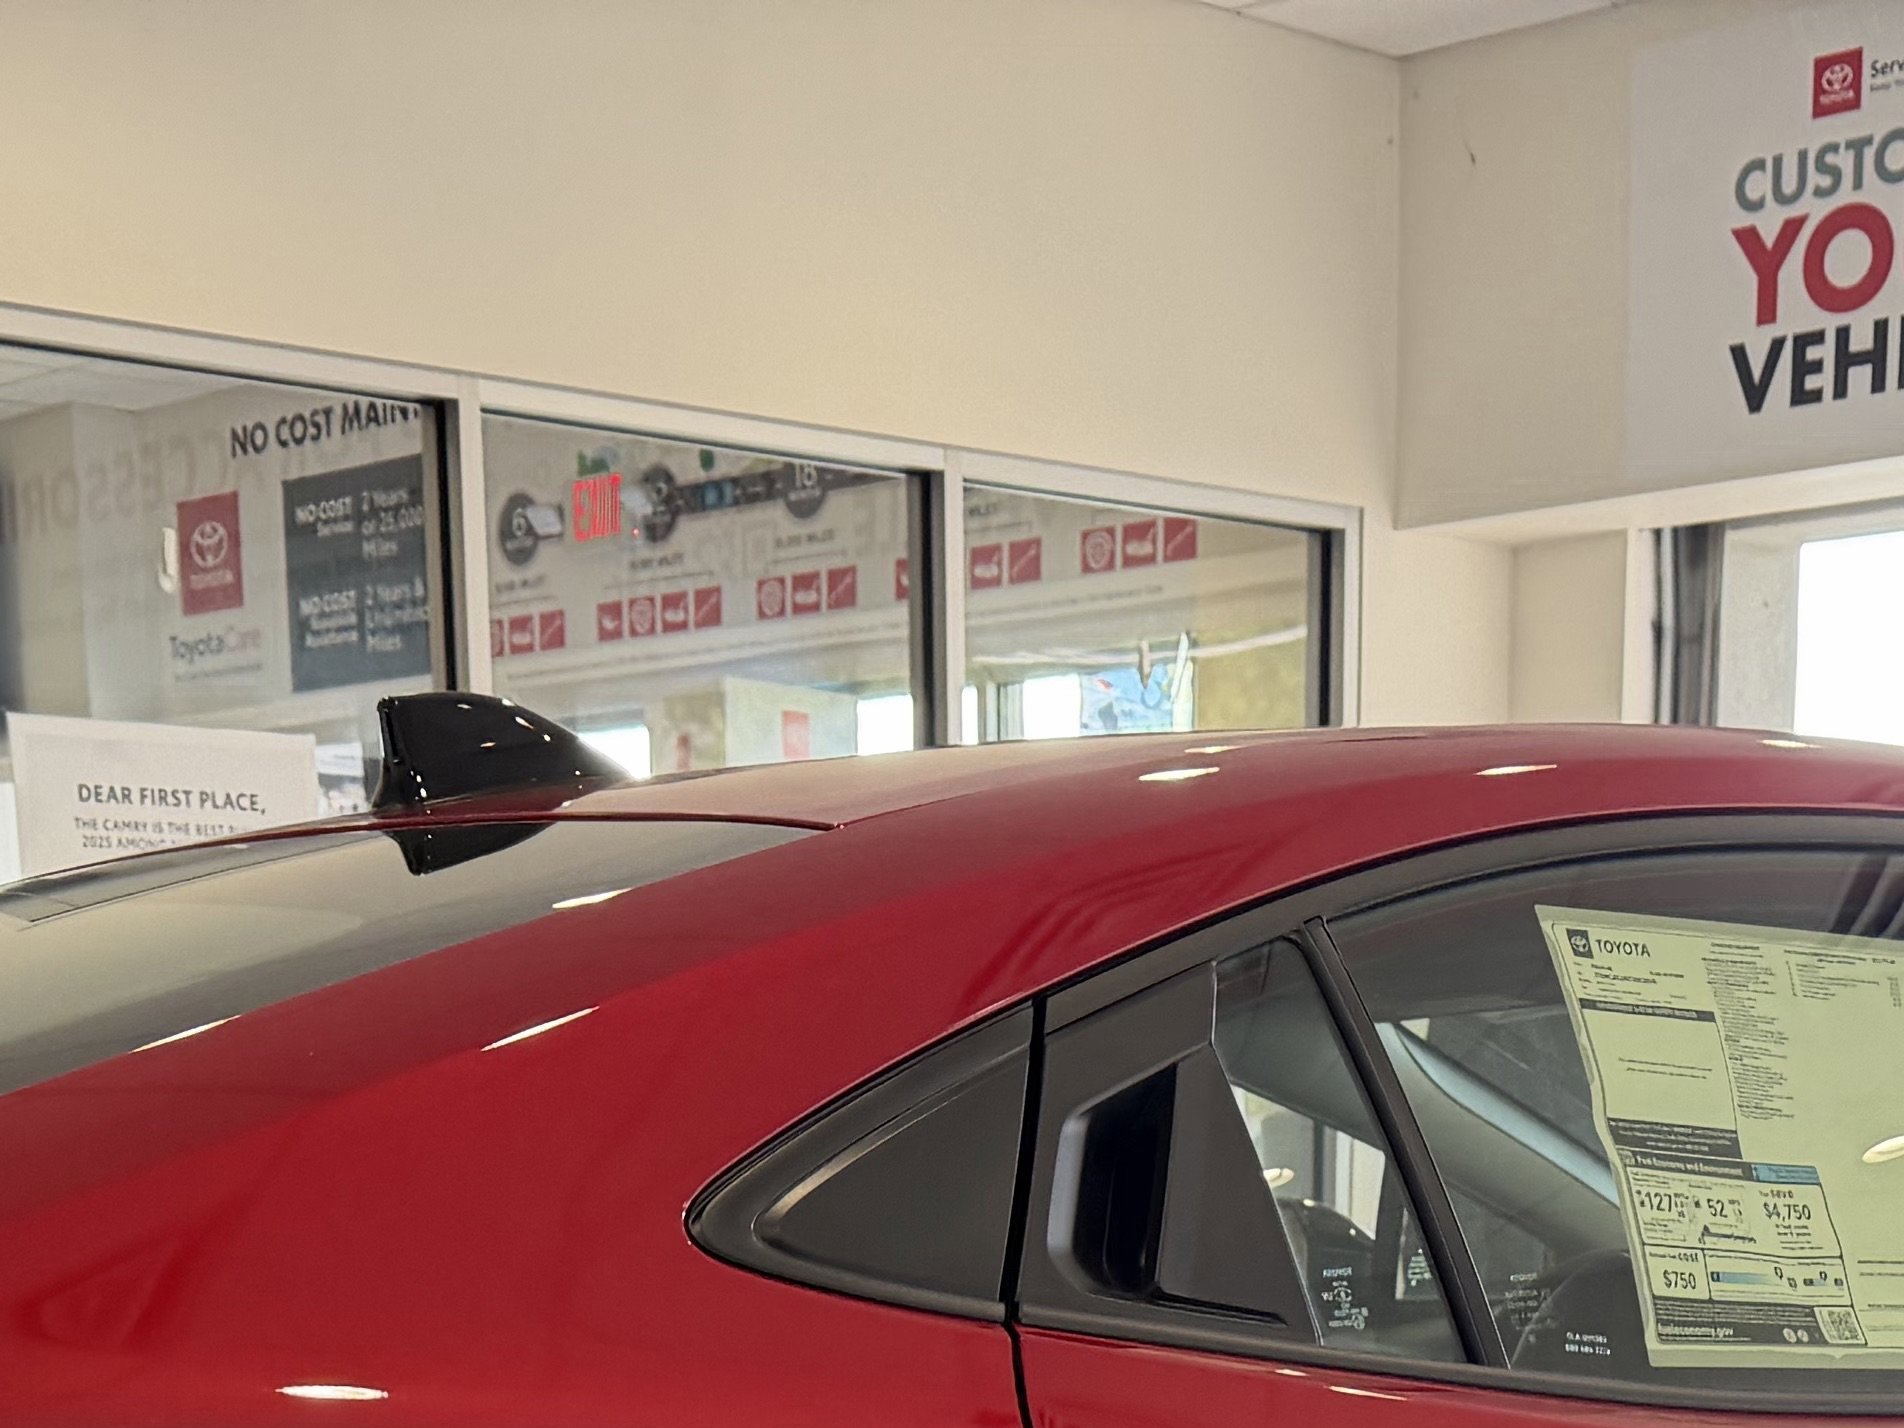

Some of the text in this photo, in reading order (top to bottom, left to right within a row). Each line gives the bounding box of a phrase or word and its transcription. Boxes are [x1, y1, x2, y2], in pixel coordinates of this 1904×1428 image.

[231, 400, 419, 458] NO COST MAIN
[77, 783, 266, 815] DEAR FIRST PLACE,
[1595, 939, 1652, 958] TOYOTA
[1707, 1199, 1729, 1218] 52
[1763, 1201, 1812, 1222] $4,750
[1663, 1270, 1697, 1290] $750
